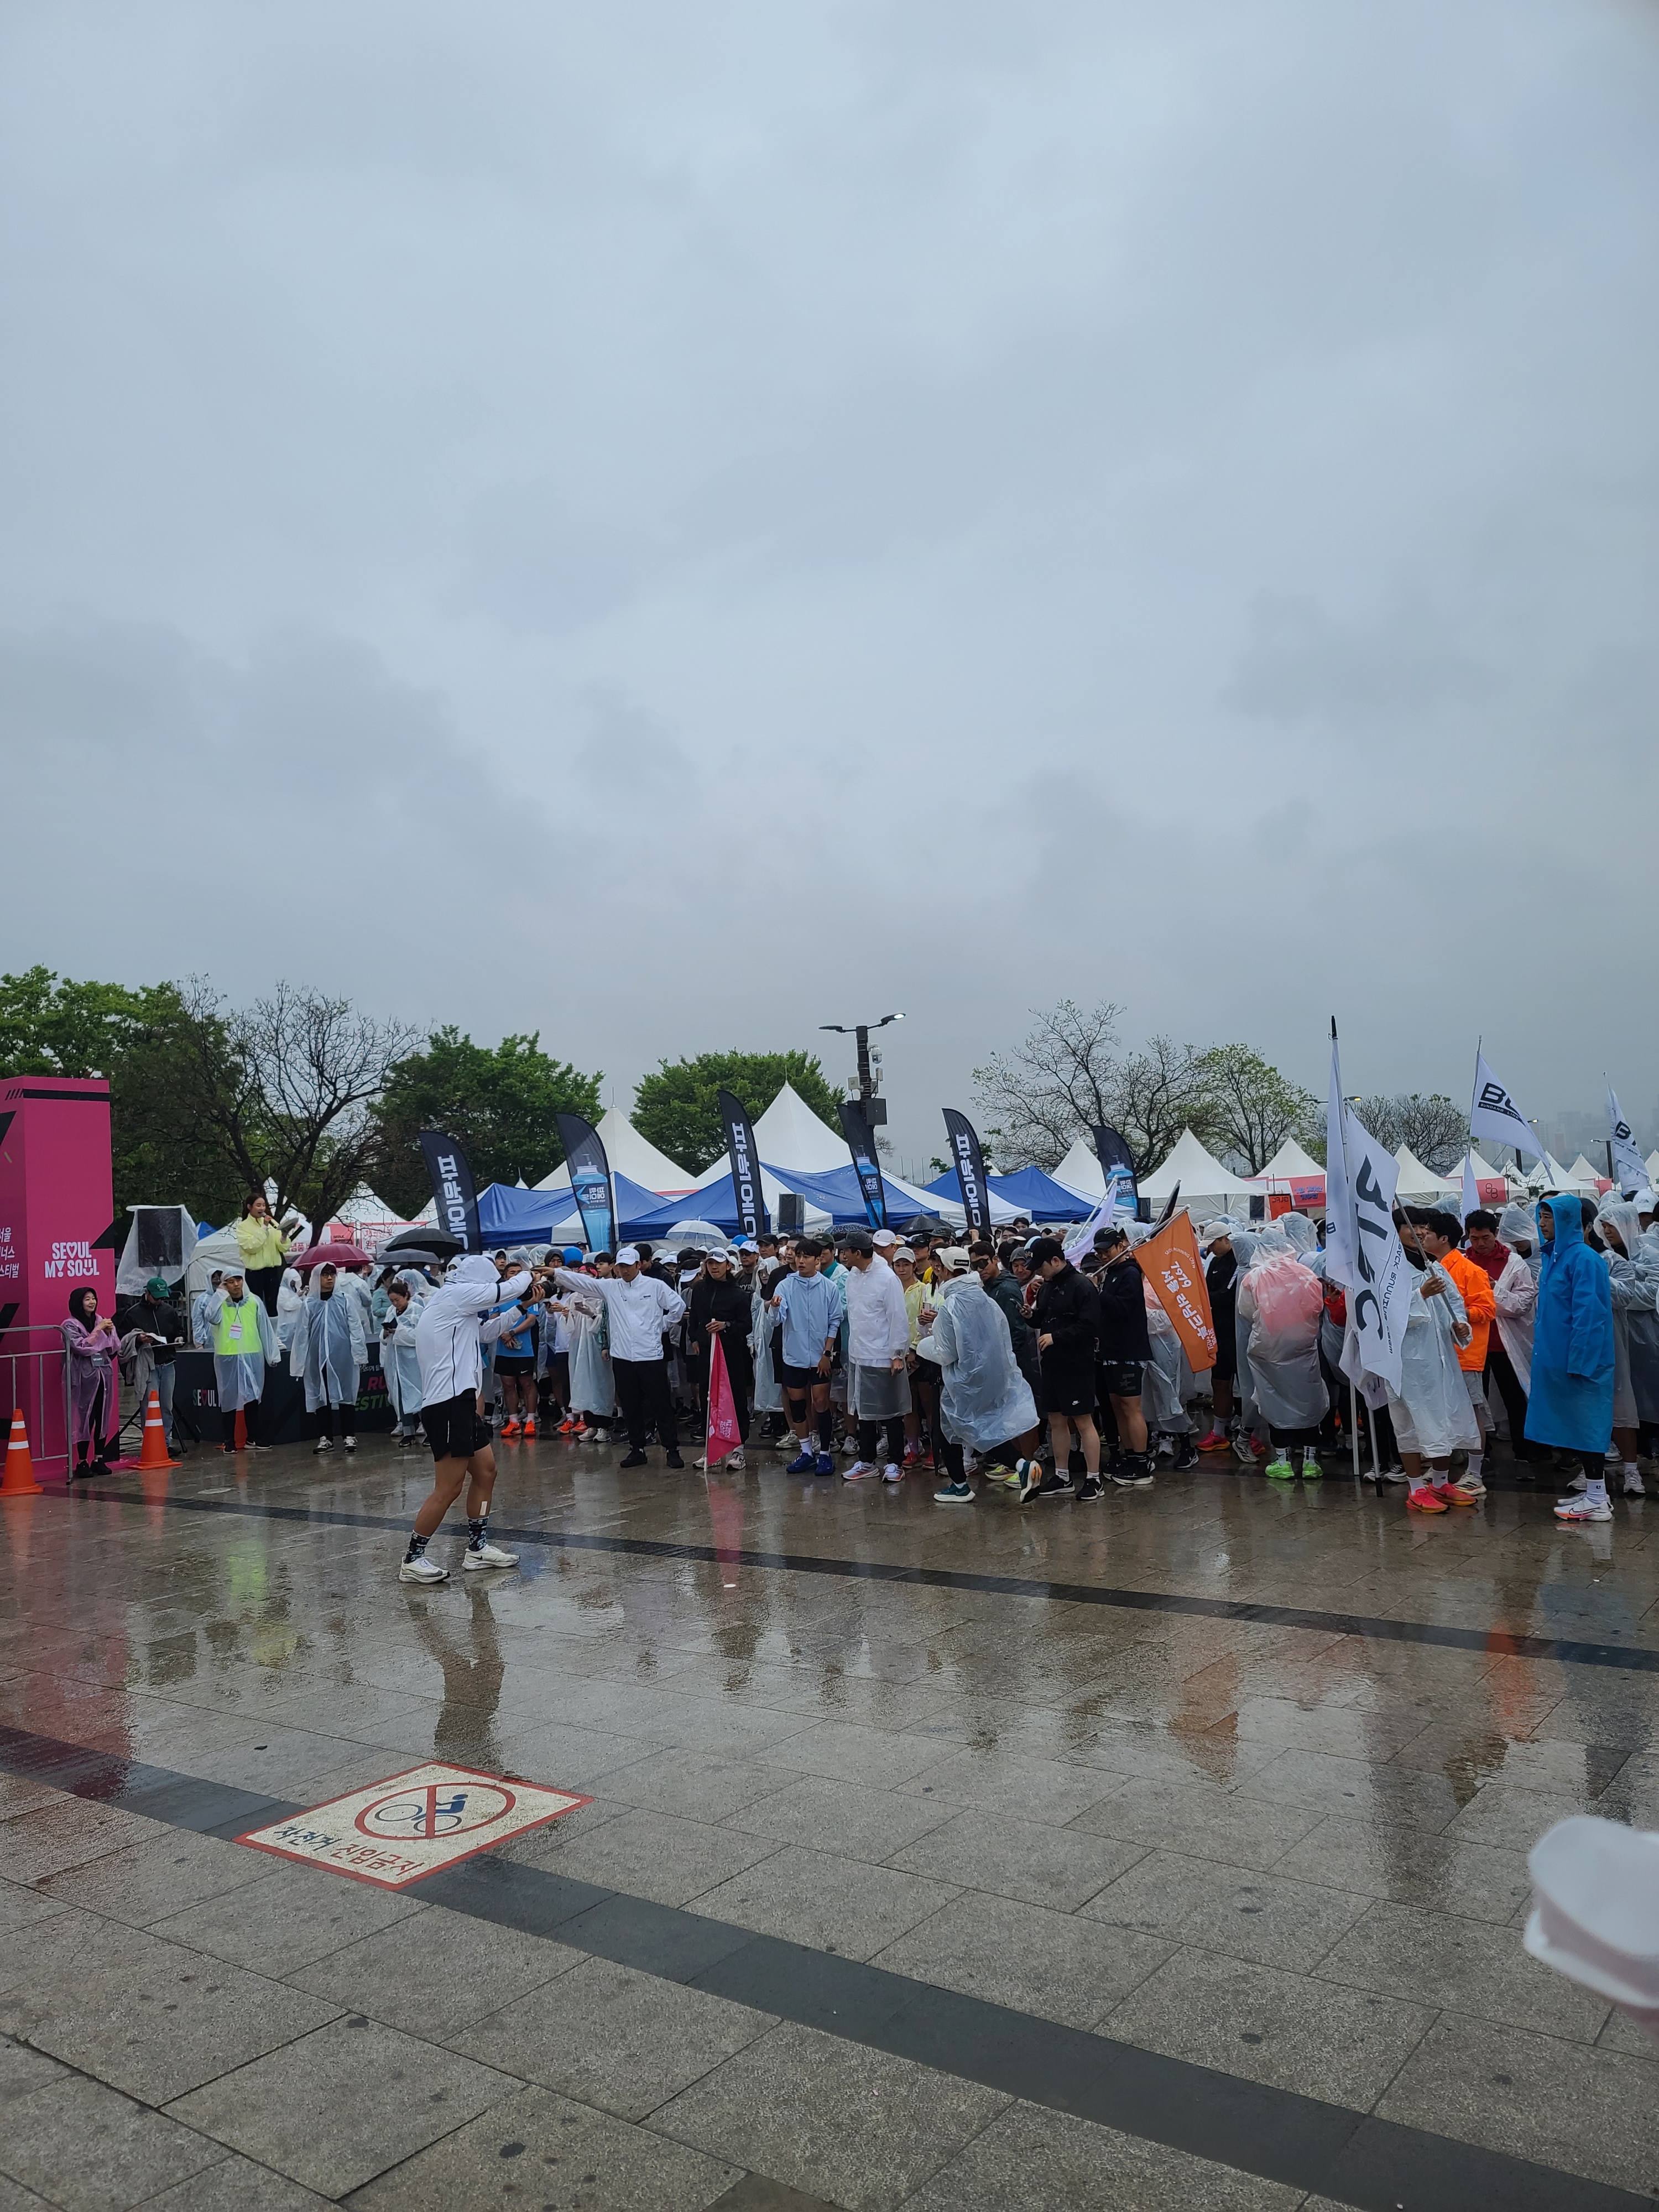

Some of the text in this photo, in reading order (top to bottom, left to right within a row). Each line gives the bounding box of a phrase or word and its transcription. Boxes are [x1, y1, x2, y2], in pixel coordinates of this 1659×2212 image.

[52, 1241, 92, 1260] SEOUL
[67, 1259, 99, 1277] SOUL
[1171, 1261, 1192, 1288] 7979
[1161, 1270, 1208, 1340] 서울 러닝크루
[273, 1827, 425, 1876] 자전거 진입금지
